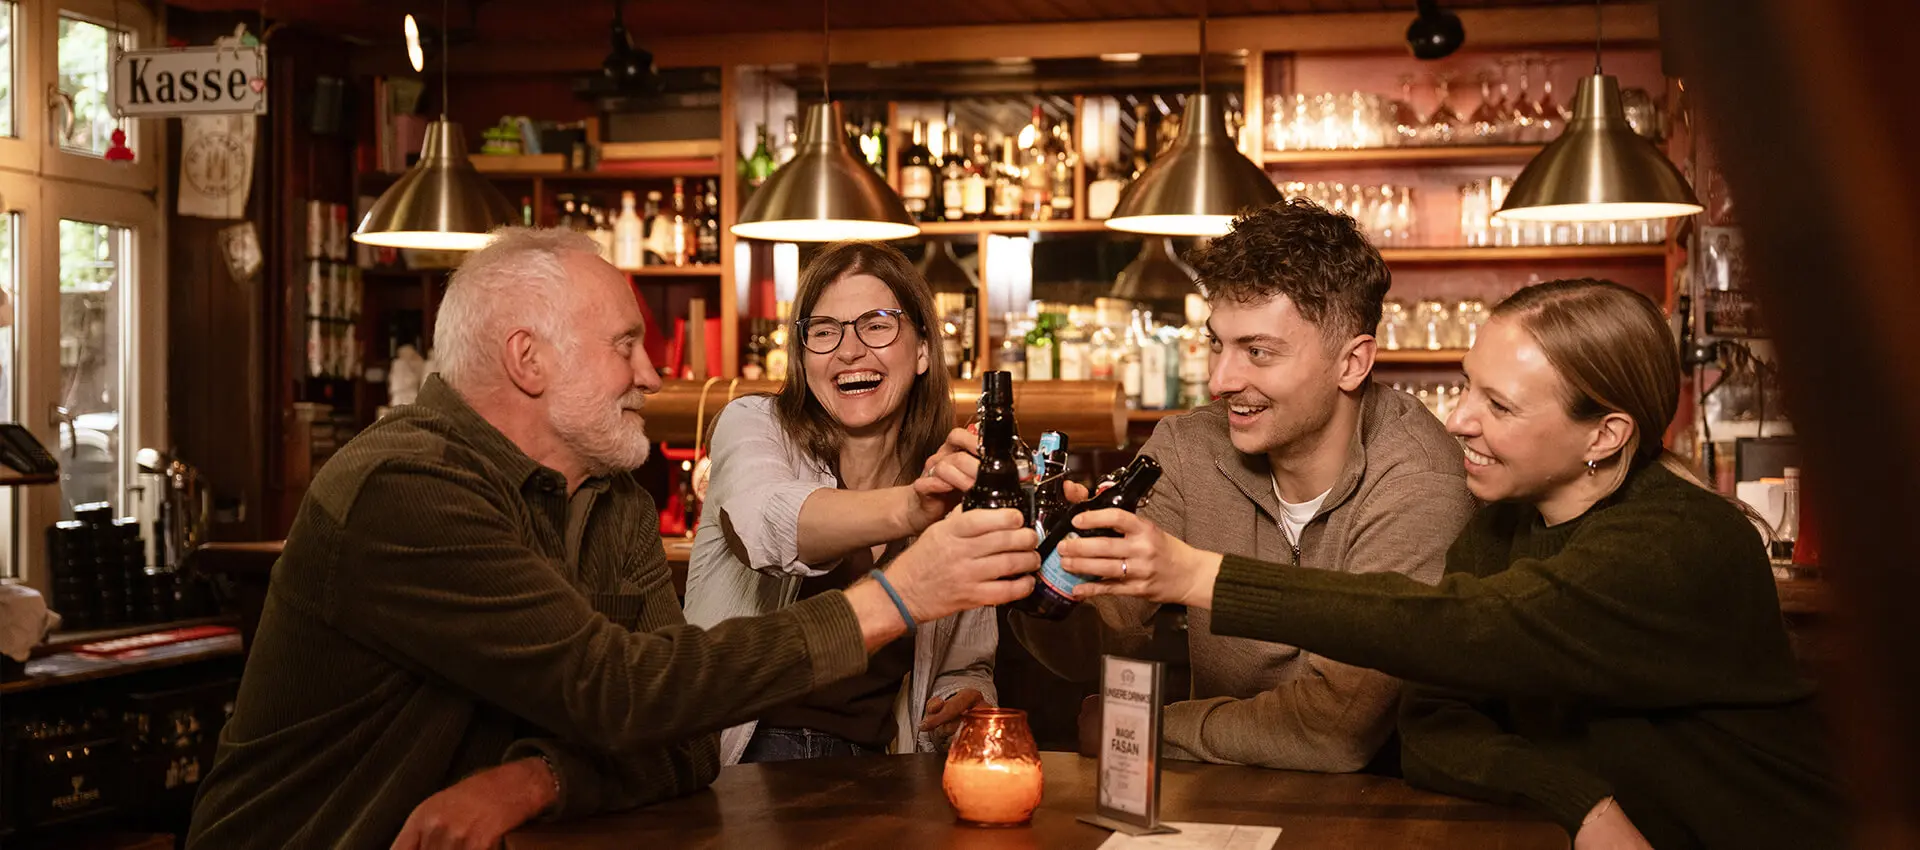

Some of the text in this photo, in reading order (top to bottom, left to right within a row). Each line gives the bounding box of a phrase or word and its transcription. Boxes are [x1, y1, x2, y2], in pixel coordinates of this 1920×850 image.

[129, 57, 246, 104] Kasse
[1104, 687, 1128, 700] UNSERE
[1115, 727, 1135, 740] MAGIC
[1111, 738, 1139, 757] FASAN
